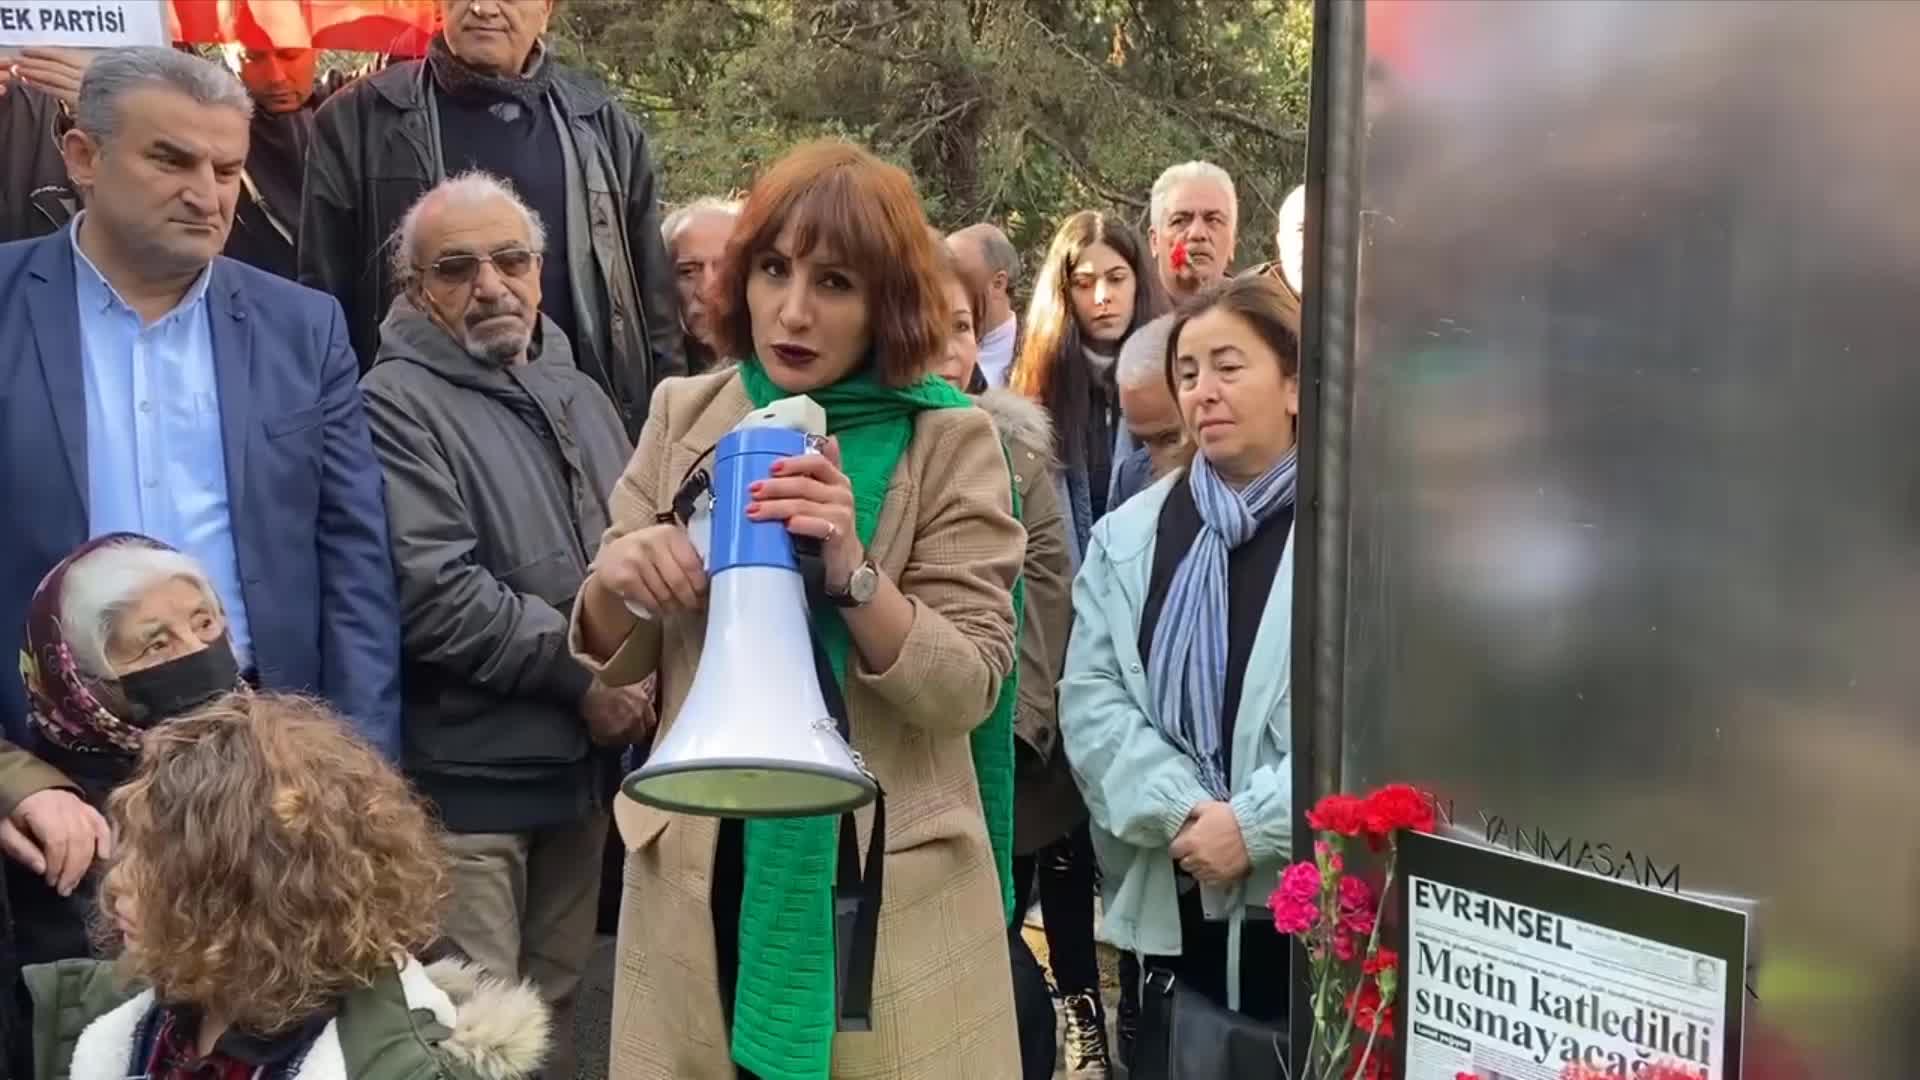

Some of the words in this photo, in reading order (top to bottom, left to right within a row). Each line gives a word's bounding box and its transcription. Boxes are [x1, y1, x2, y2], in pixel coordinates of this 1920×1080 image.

[39, 5, 126, 33] PARTİSİ
[1478, 808, 1681, 894] YANMASAM
[1417, 940, 1517, 1008] Metin
[1529, 973, 1711, 1066] katledildi
